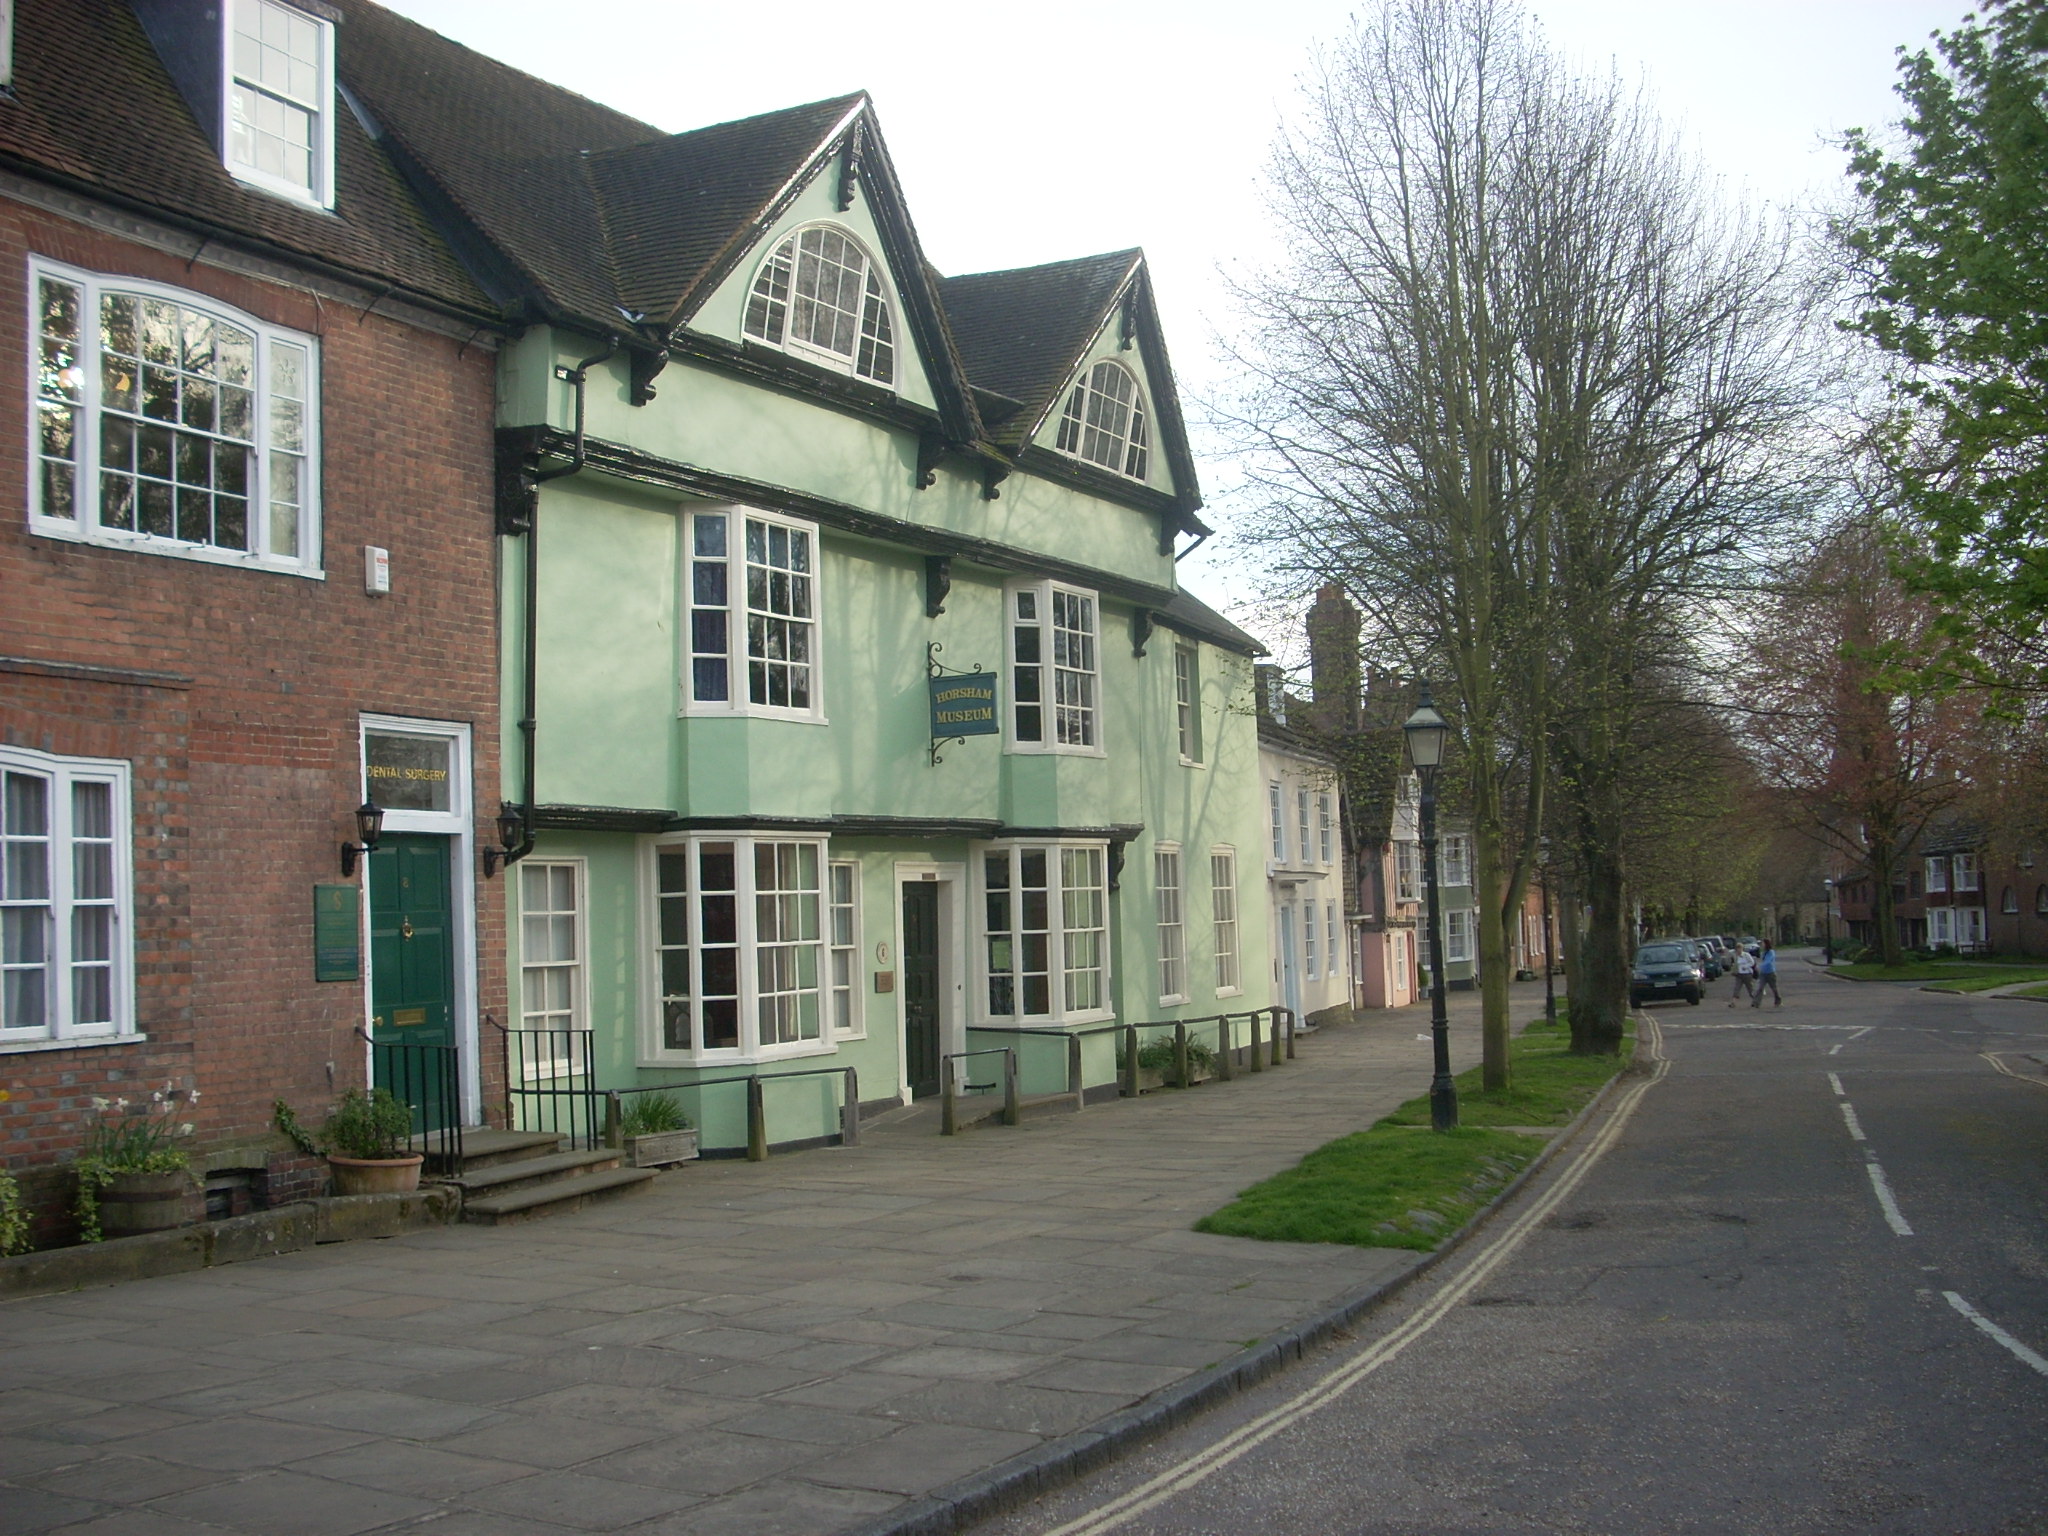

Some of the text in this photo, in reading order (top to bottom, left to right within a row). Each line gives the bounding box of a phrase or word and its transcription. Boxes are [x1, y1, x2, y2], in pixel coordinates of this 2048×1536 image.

[936, 687, 992, 704] HORSHAM
[936, 707, 992, 723] MUSEUM
[366, 765, 446, 781] DENTAL SURGERY
